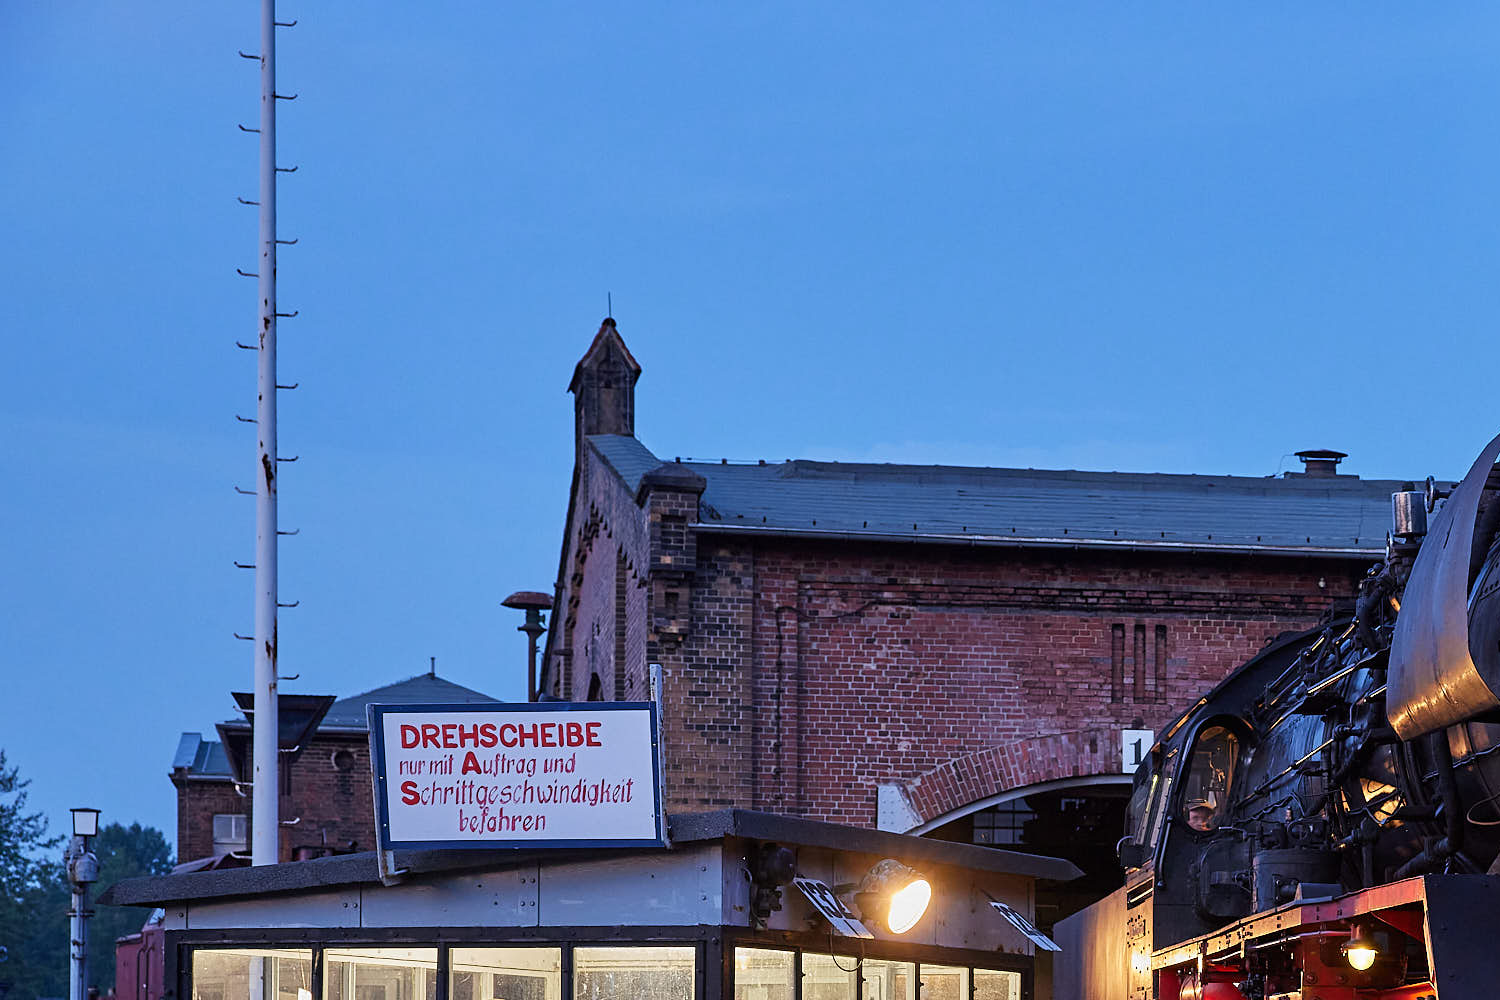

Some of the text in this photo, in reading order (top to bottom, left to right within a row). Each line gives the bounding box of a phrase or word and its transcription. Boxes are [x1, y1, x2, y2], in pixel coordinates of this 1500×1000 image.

[400, 722, 602, 749] DREHSCHEIBE
[399, 751, 576, 777] nur mit Auftrag und
[1129, 738, 1143, 766] 1
[400, 778, 634, 809] Schrittgeschwindigkeit
[459, 807, 546, 835] befahren
